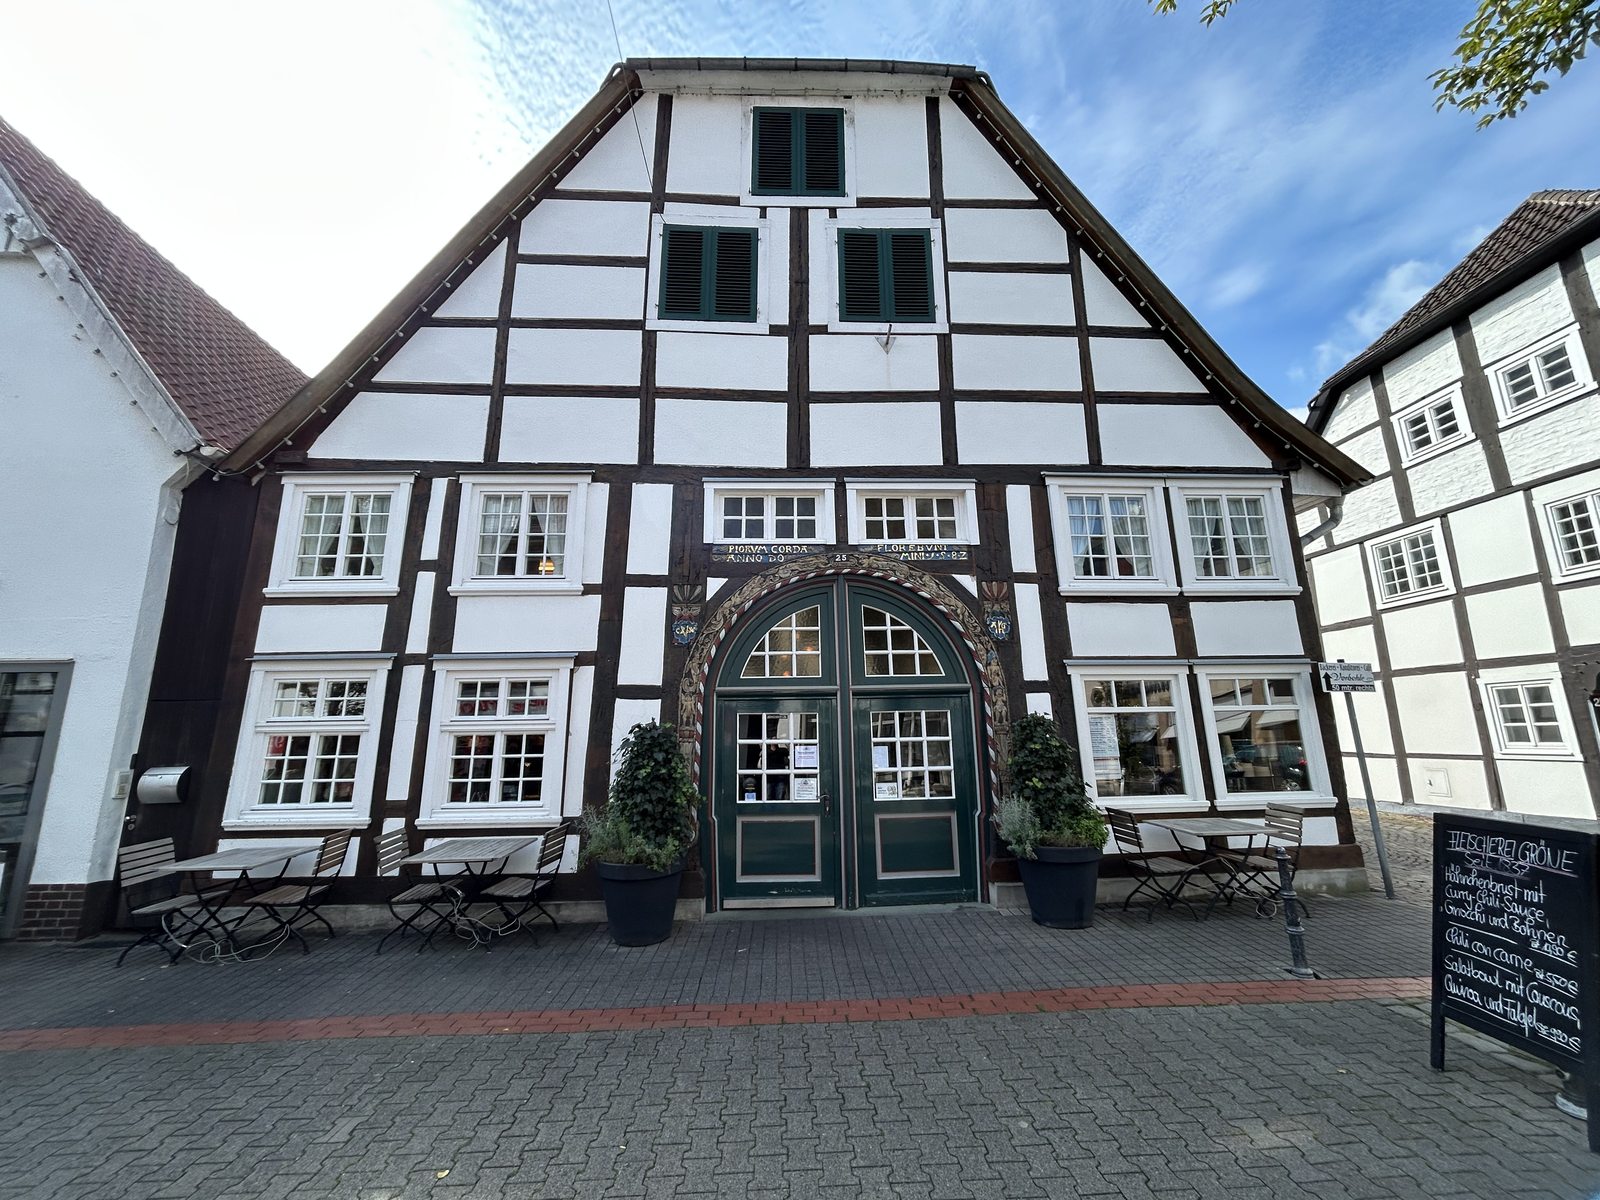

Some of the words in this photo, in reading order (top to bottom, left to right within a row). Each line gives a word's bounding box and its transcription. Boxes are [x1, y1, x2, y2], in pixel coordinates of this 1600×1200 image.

[727, 554, 763, 562] ANNO
[768, 554, 785, 562] DO
[728, 545, 767, 553] PIORVM
[771, 545, 808, 553] CORDA
[1518, 839, 1579, 872] GRÖNE
[1445, 863, 1522, 899] Hähnchenbrust
[1524, 880, 1547, 903] mit
[1444, 900, 1485, 924] Gnocchi
[1489, 913, 1510, 929] und
[1509, 917, 1570, 948] Bohnen
[1445, 927, 1469, 948] Chili
[1472, 941, 1492, 957] con
[1444, 954, 1503, 988] Salatbowl
[1505, 974, 1525, 997] mit
[1444, 974, 1482, 1005] Quinoa
[1484, 993, 1503, 1014] und
